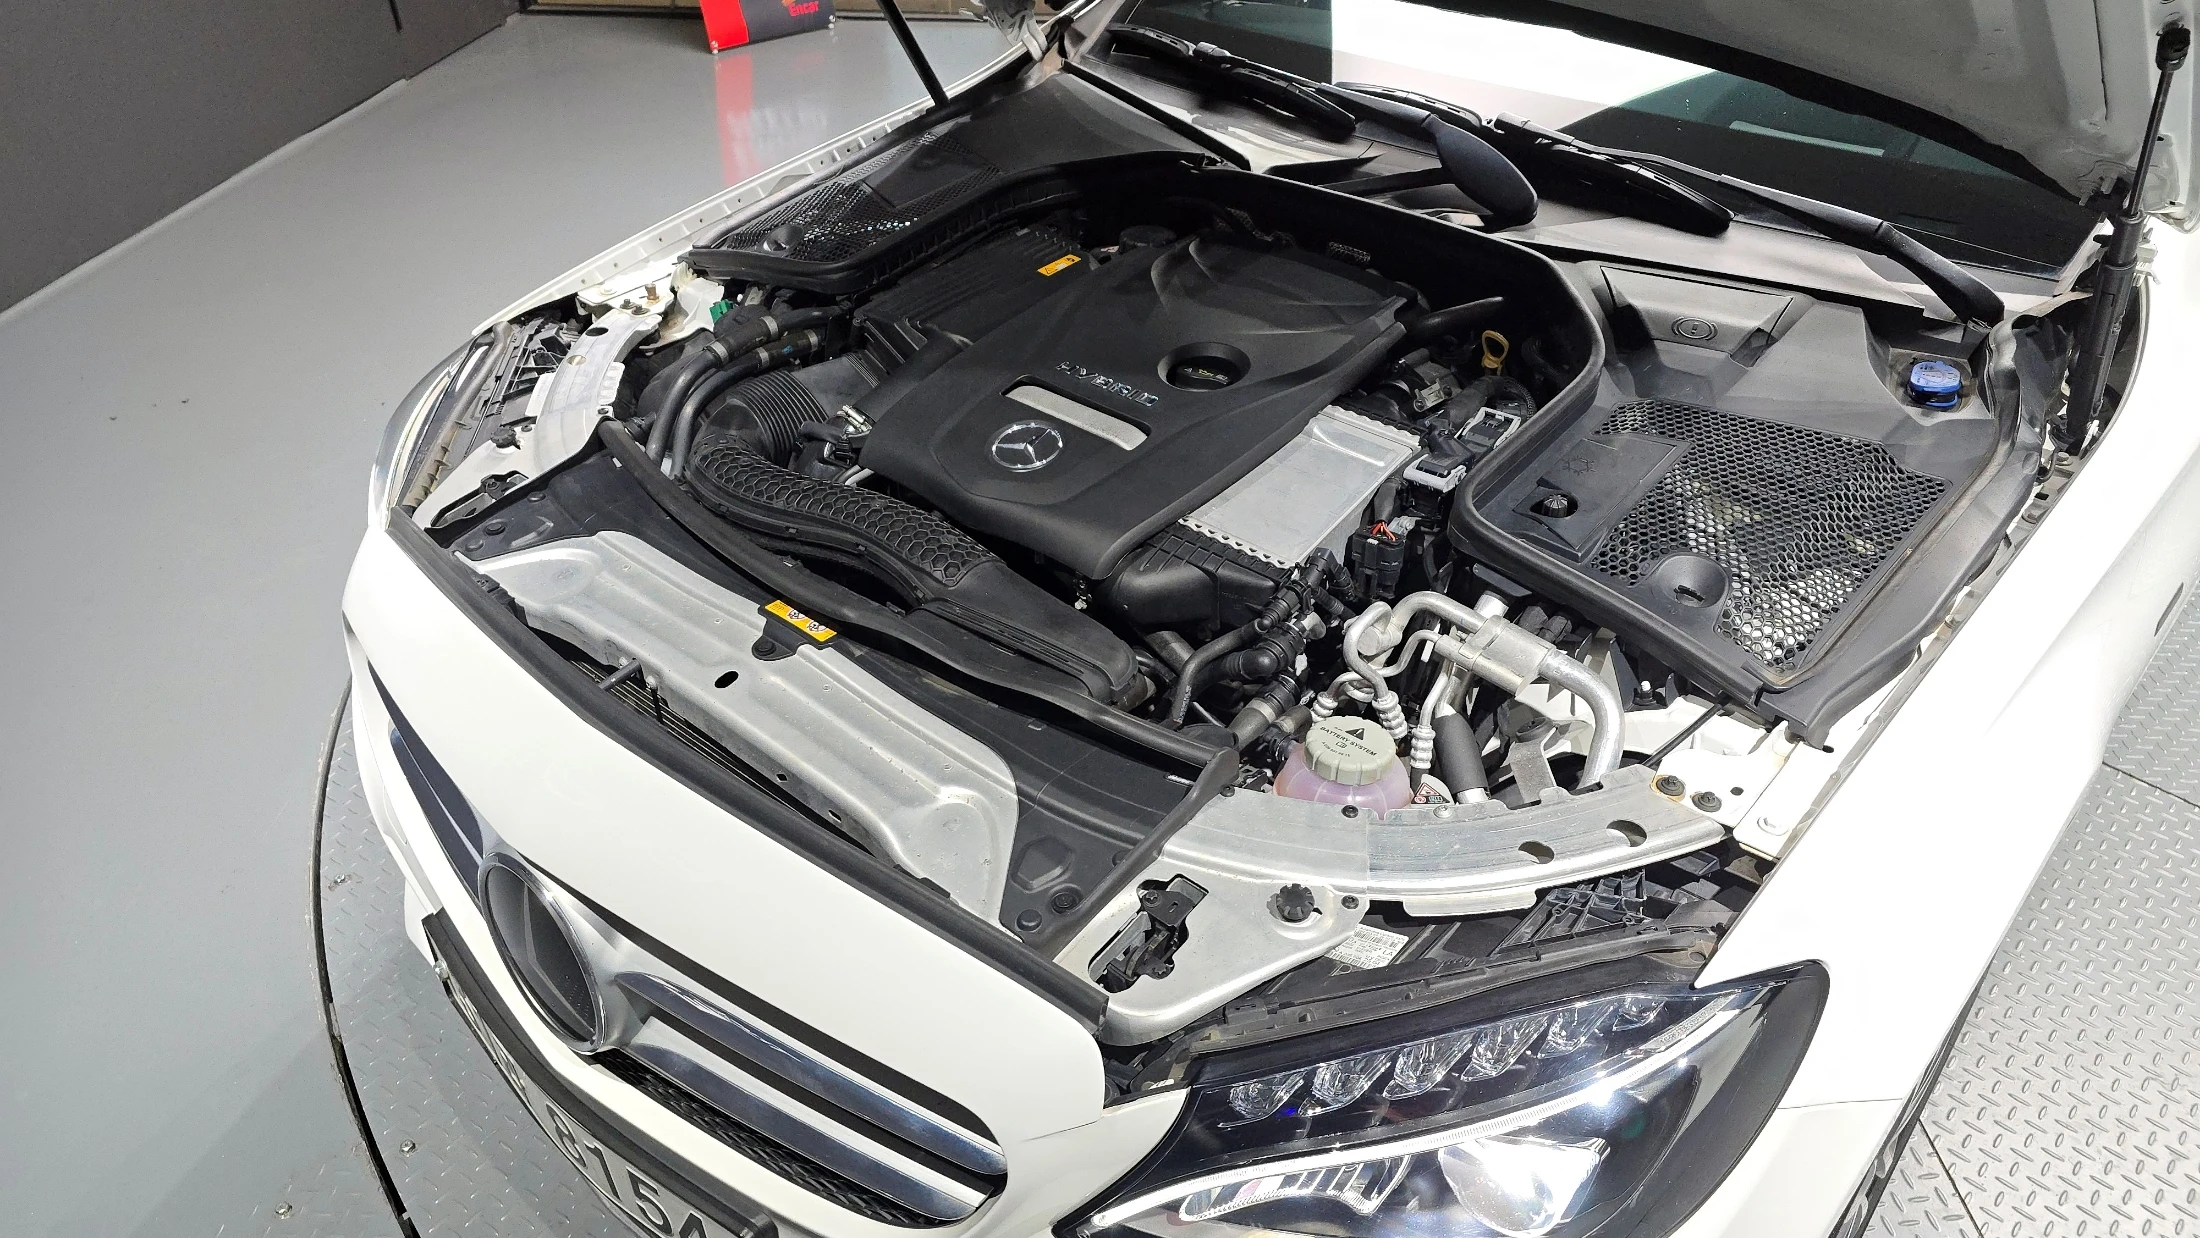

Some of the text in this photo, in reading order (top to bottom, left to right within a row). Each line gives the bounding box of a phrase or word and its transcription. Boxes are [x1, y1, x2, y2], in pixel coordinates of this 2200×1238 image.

[789, 2, 819, 16] Encar
[1055, 361, 1159, 407] HYBRID
[1319, 726, 1350, 742] BATTERY
[1349, 741, 1378, 757] SYSTEM
